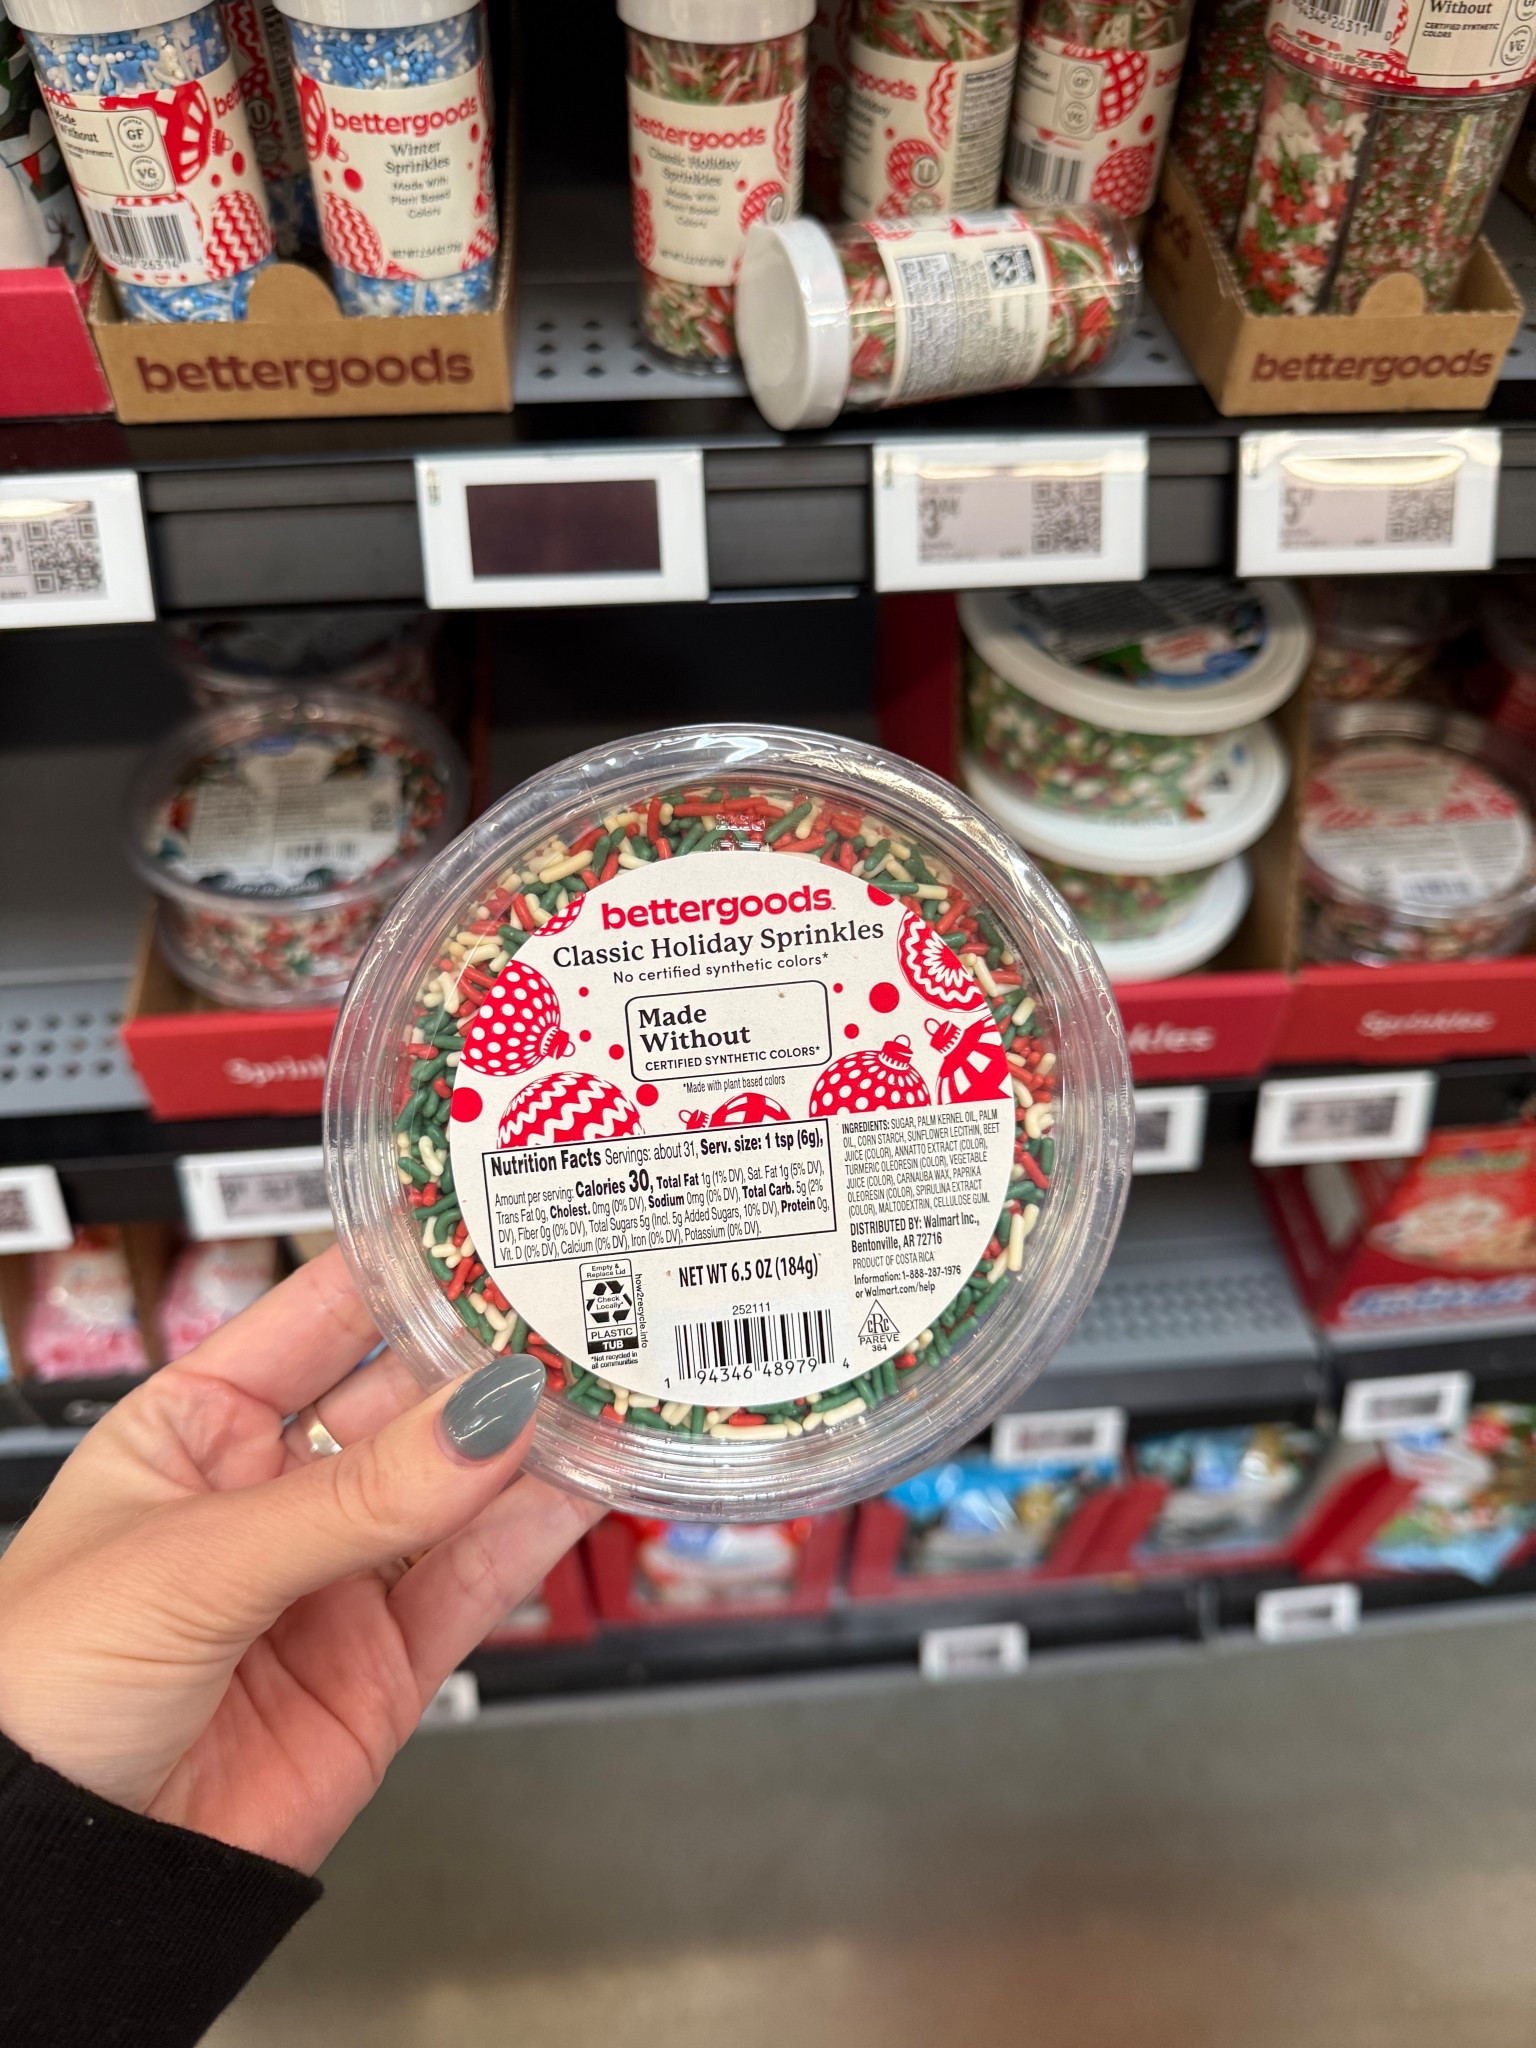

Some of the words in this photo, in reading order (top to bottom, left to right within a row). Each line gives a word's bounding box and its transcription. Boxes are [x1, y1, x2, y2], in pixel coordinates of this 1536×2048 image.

[331, 97, 478, 137] bettergoods
[126, 128, 145, 141] GF
[136, 167, 157, 180] VG
[135, 348, 474, 396] bettergoods
[1251, 348, 1494, 386] bettergoods
[553, 940, 645, 968] Classic
[650, 932, 754, 959] Holiday
[760, 919, 884, 953] Sprinkles
[613, 971, 634, 984] No
[638, 963, 701, 982] certified
[706, 958, 773, 978] synthetic
[637, 1004, 707, 1029] Made
[639, 1026, 751, 1053] Without
[645, 1057, 702, 1071] CERTIFIED
[705, 1050, 767, 1066] SYNTHETIC
[706, 1079, 722, 1091] with
[723, 1078, 741, 1092] plant
[741, 1075, 763, 1088] based
[764, 1074, 786, 1086] colors
[841, 1119, 890, 1134] INGREDIENTS:
[891, 1116, 916, 1130] SUGAR,
[917, 1115, 936, 1126] PALM
[937, 1112, 964, 1125] KERNEL
[965, 1111, 978, 1123] OIL,
[979, 1109, 998, 1120] PALM
[843, 1137, 856, 1148] OIL,
[857, 1134, 877, 1147] CORN
[877, 1132, 906, 1145] STARCH,
[907, 1127, 949, 1142] SUNFLOWER
[950, 1124, 982, 1138] LECITHIN,
[983, 1122, 1000, 1135] BEET
[490, 1152, 557, 1177] Nutrition
[560, 1147, 602, 1170] Facts
[605, 1146, 652, 1167] Servings:
[653, 1142, 682, 1161] about
[683, 1140, 699, 1159] 31,
[700, 1138, 732, 1156] Serv.
[734, 1134, 762, 1152] size:
[765, 1132, 771, 1149] 1
[774, 1132, 794, 1151] tsp
[797, 1127, 824, 1150] (6g),
[844, 1149, 863, 1162] JUICE
[864, 1147, 893, 1162] (COLOR),
[895, 1143, 926, 1156] ANNATTO
[927, 1140, 957, 1154] EXTRACT
[960, 1137, 988, 1152] (COLOR),
[494, 1191, 527, 1207] Amount
[527, 1192, 541, 1206] per
[542, 1186, 574, 1202] serving:
[575, 1177, 626, 1198] Calories
[628, 1168, 654, 1193] 30,
[655, 1173, 682, 1190] Total
[683, 1172, 700, 1187] Fat
[701, 1172, 711, 1187] 1g
[712, 1170, 728, 1187] (1%
[728, 1167, 746, 1184] DV),
[747, 1166, 763, 1181] Sat.
[764, 1165, 778, 1179] Fat
[779, 1164, 789, 1179] 1g
[790, 1162, 806, 1178] (5%
[807, 1160, 825, 1175] DV),
[495, 1211, 519, 1225] Trans
[520, 1206, 534, 1222] Fat
[535, 1207, 549, 1223] 0g,
[549, 1201, 591, 1219] Cholest.
[592, 1201, 611, 1216] 0mg
[611, 1199, 628, 1215] (0%
[628, 1196, 647, 1212] DV),
[648, 1193, 685, 1209] Sodium
[686, 1191, 705, 1206] 0mg
[706, 1186, 722, 1205] (0%
[723, 1186, 741, 1202] DV),
[741, 1183, 767, 1199] Total
[768, 1178, 795, 1196] Carb.
[796, 1180, 807, 1195] 5g
[807, 1175, 824, 1195] (2%
[848, 1203, 877, 1219] (COLOR),
[878, 1198, 932, 1213] MALTODEXTRIN,
[933, 1193, 971, 1208] CELLULOSE
[972, 1192, 990, 1204] GUM.
[850, 1218, 906, 1236] DISTRIBUTED
[908, 1216, 922, 1230] BY:
[923, 1213, 960, 1229] Walmart
[961, 1212, 980, 1226] Inc.,
[851, 1236, 901, 1253] Bentonville,
[903, 1234, 915, 1248] AR
[916, 1231, 943, 1246] 72716
[591, 1264, 613, 1273] Empty
[678, 1265, 704, 1288] NET
[706, 1262, 728, 1285] WT
[731, 1261, 752, 1282] 6.5
[755, 1258, 773, 1280] OZ
[775, 1252, 818, 1281] (184g)
[852, 1255, 884, 1269] PRODUCT
[885, 1254, 894, 1266] OF
[895, 1252, 918, 1265] COSTA
[918, 1251, 934, 1262] RICA
[586, 1270, 614, 1278] Replace
[854, 1271, 901, 1285] Information:
[902, 1264, 961, 1280] 1-888-287-1976
[855, 1290, 864, 1299] or
[864, 1280, 936, 1297] Walmart.com/help
[635, 1273, 649, 1349] how2recycle.info
[732, 1302, 770, 1316] 252111
[591, 1327, 633, 1340] PLASTIC
[601, 1339, 625, 1351] TUB
[859, 1334, 899, 1346] PAREVE
[605, 1351, 631, 1361] recycled
[872, 1343, 887, 1352] 364
[604, 1358, 639, 1367] communities
[697, 1365, 753, 1385] 94346
[762, 1358, 818, 1377] 48979
